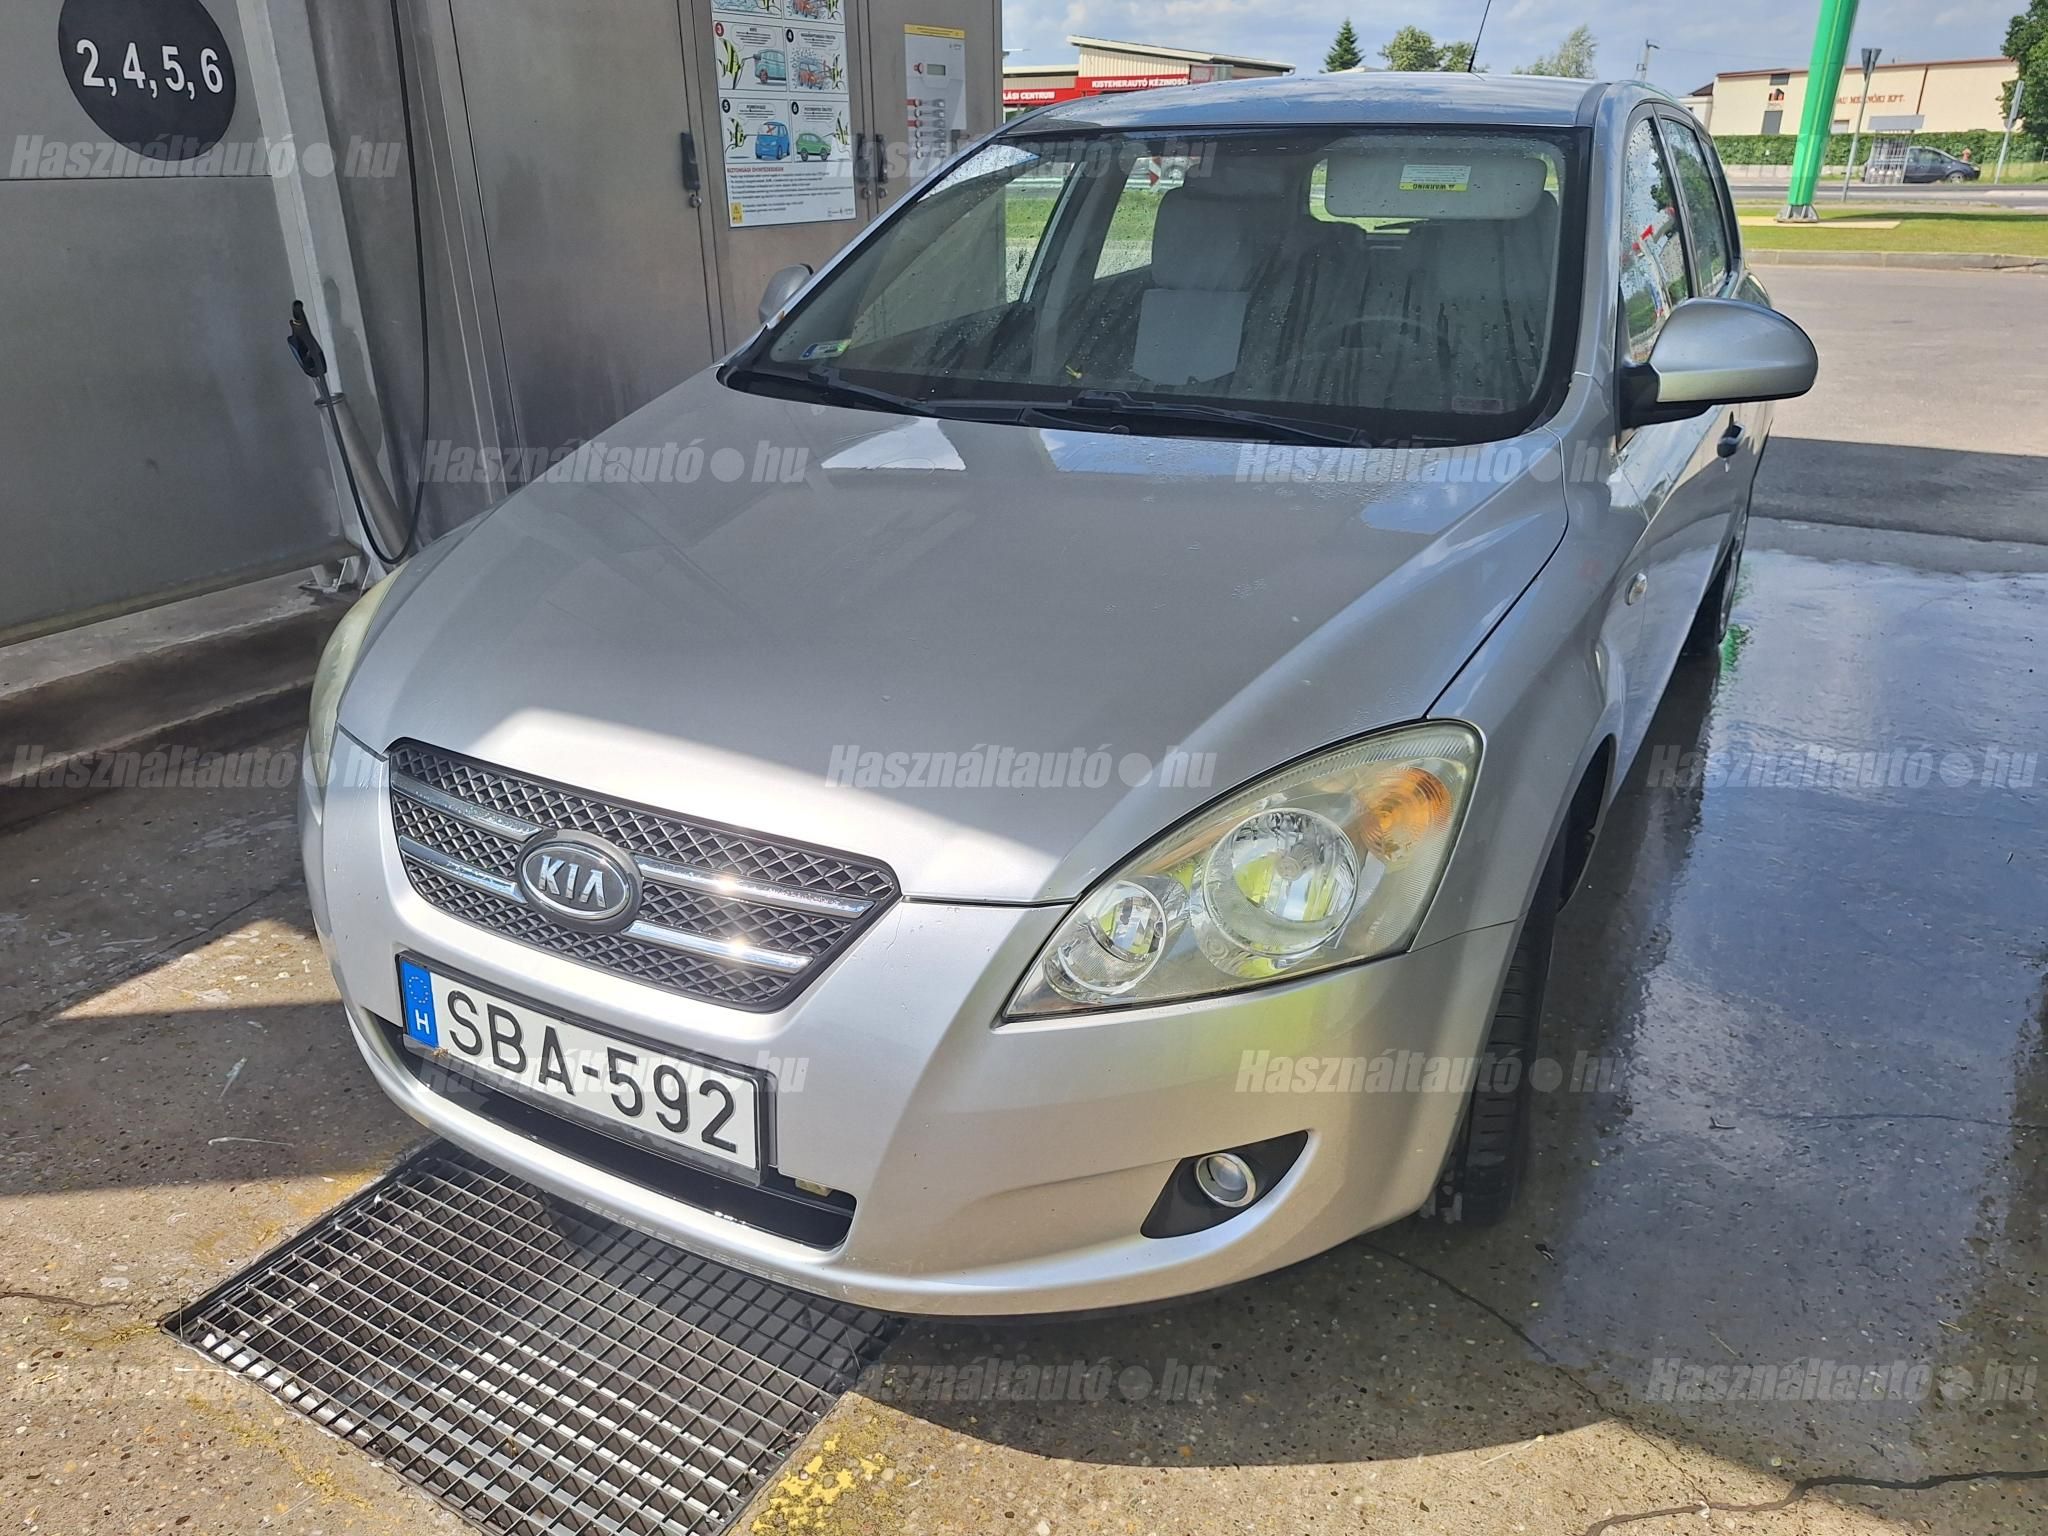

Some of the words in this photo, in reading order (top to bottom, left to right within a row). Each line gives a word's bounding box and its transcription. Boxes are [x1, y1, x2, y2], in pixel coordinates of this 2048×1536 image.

[538, 854, 609, 909] KIA
[415, 1010, 430, 1035] H
[446, 989, 737, 1155] SBA-592
